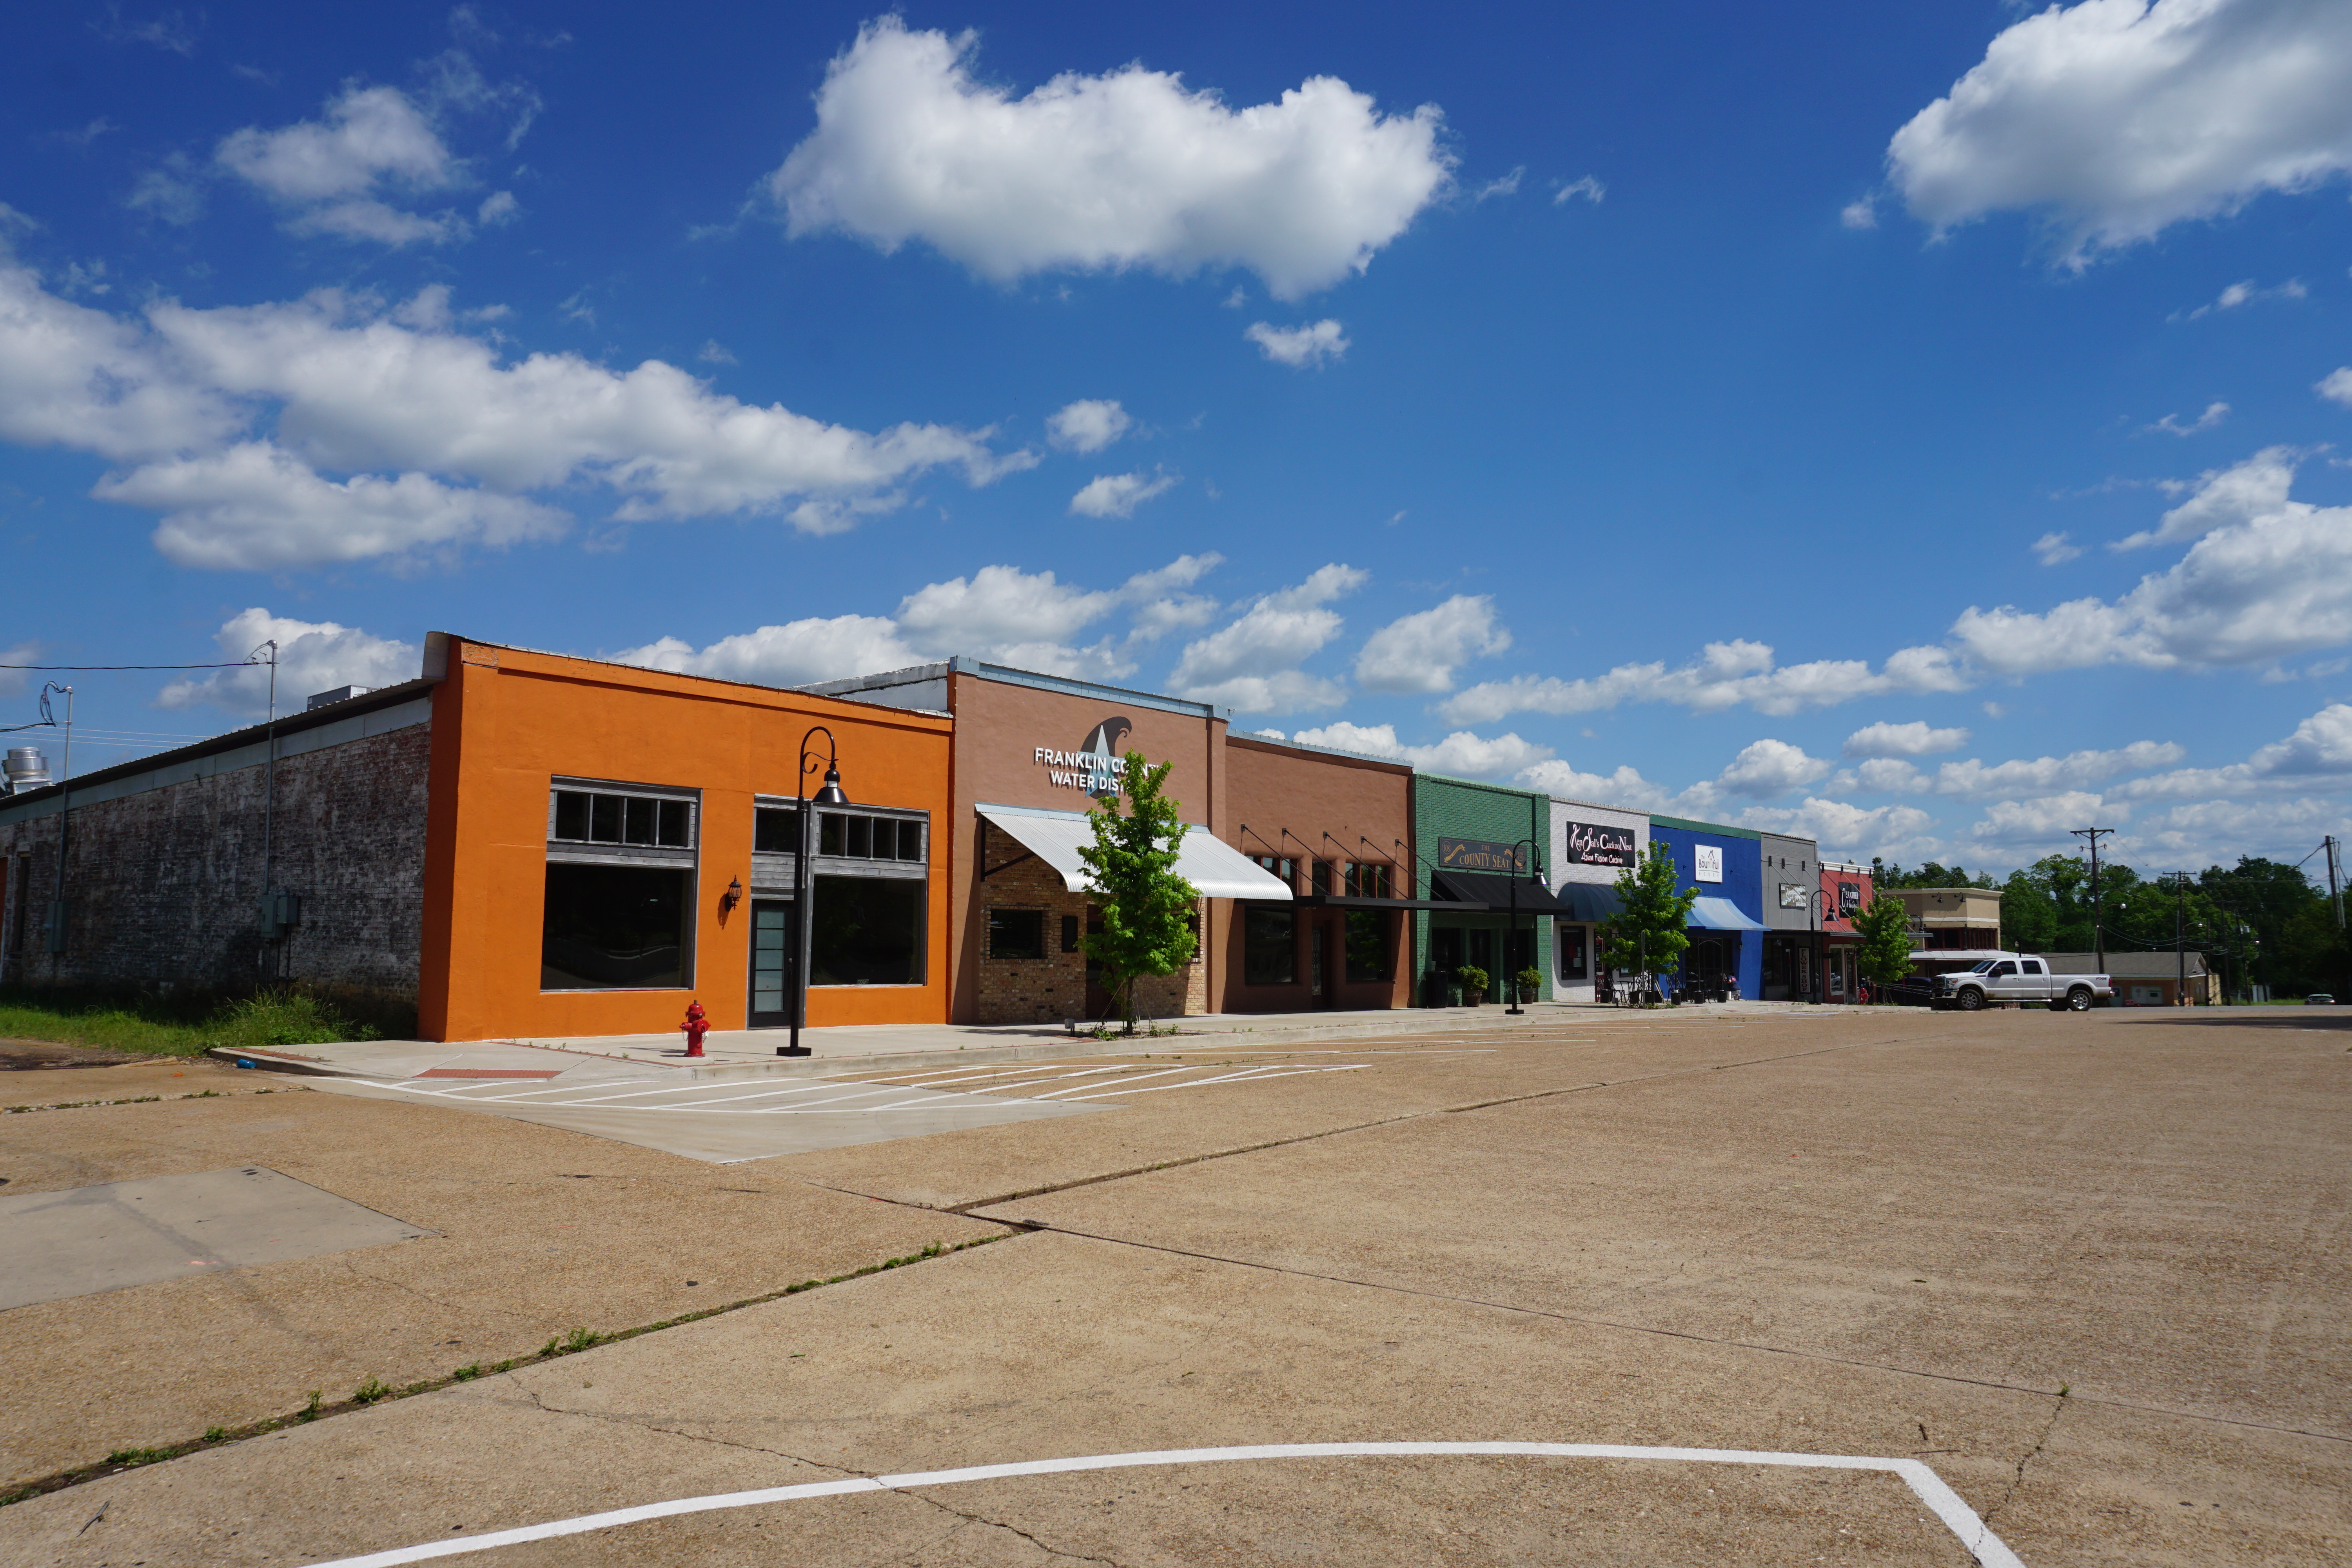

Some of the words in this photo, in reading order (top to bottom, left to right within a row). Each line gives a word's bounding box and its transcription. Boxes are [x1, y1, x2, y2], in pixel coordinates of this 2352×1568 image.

[1035, 747, 1107, 771] FRANKLIN
[1050, 770, 1095, 788] WATER
[1459, 853, 1490, 867] COUNTY
[1492, 855, 1510, 868] SEAT
[1581, 851, 1593, 861] Asian
[1594, 853, 1608, 862] Fusion
[1608, 854, 1623, 864] Cuisine
[1699, 856, 1719, 870] Bountiful
